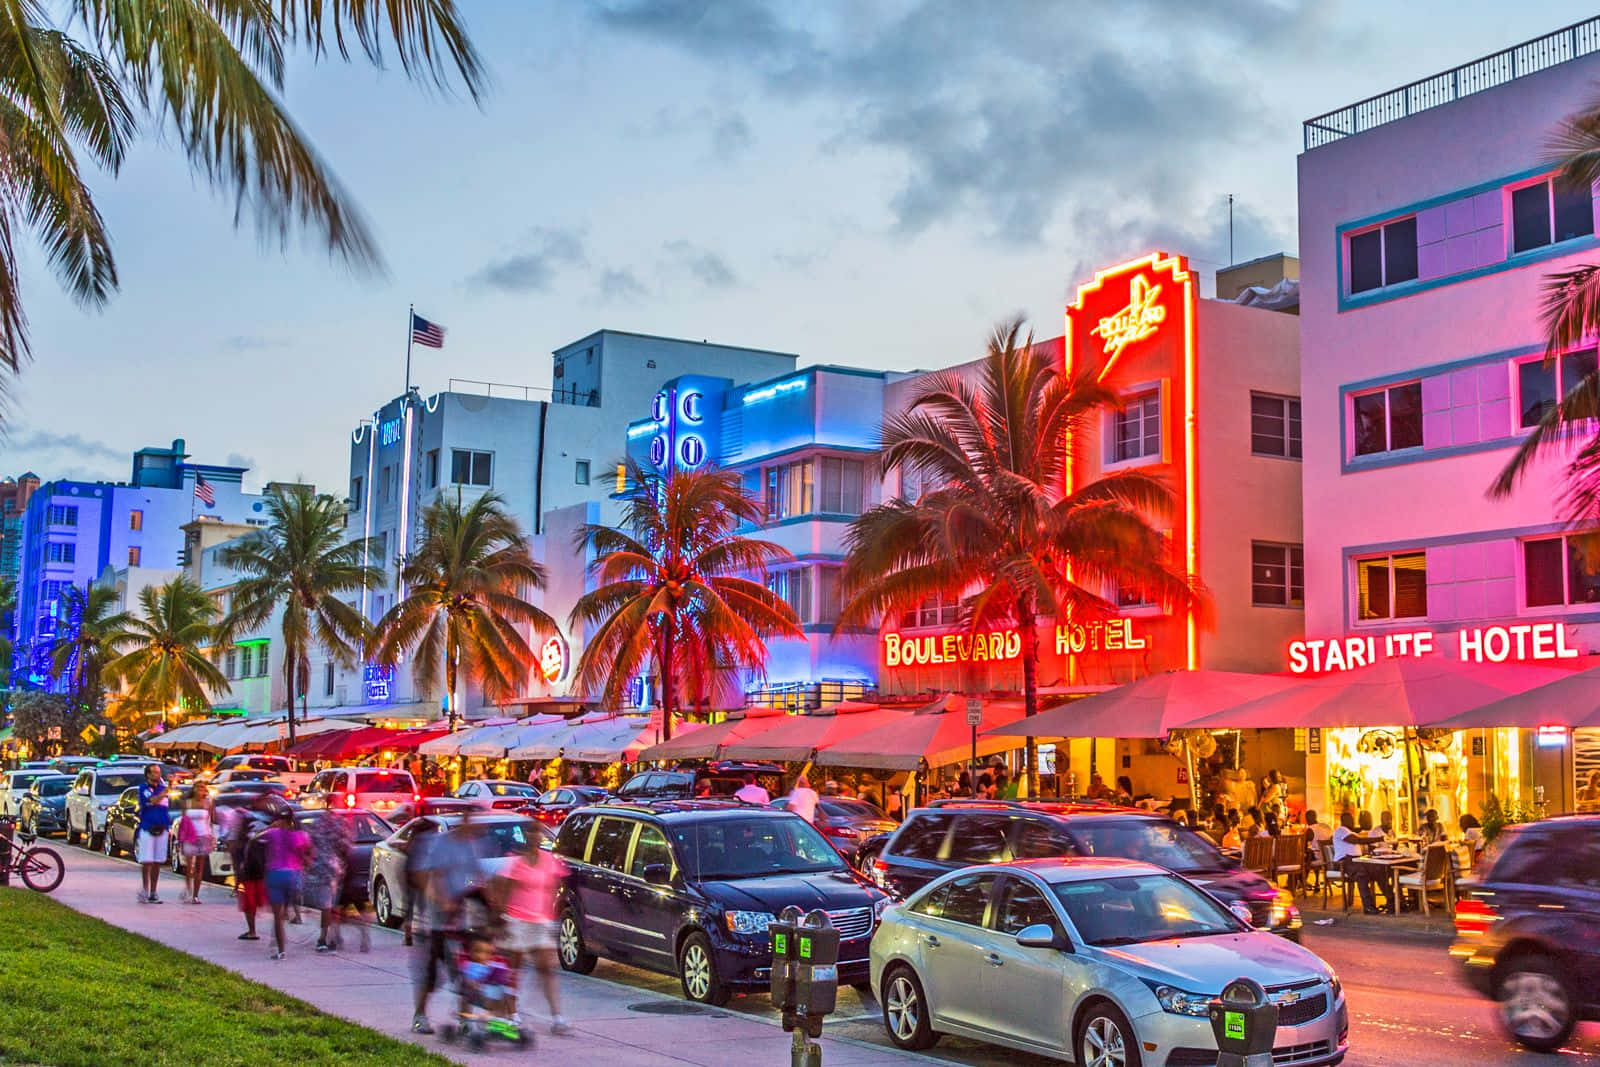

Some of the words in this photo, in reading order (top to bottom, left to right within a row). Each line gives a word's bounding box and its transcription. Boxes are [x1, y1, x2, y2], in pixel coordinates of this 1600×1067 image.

[885, 630, 1021, 666] BOULEVARD
[1056, 618, 1146, 655] HOTEL
[1460, 622, 1578, 662] HOTEL
